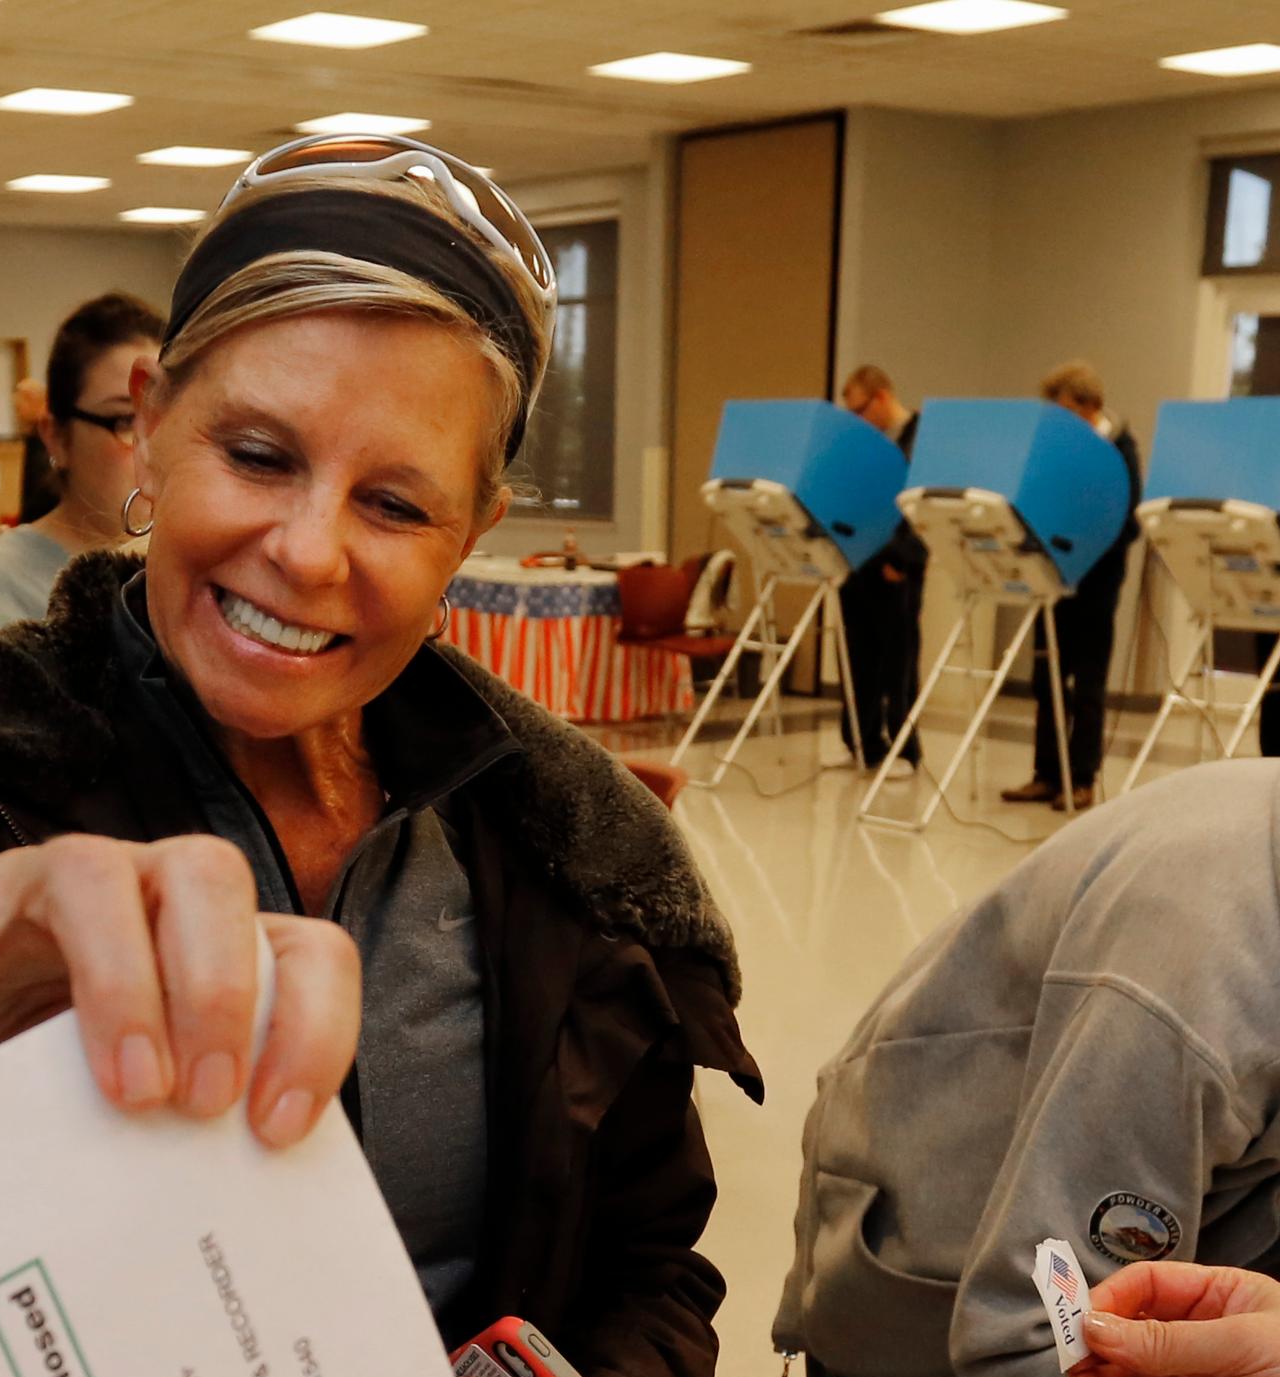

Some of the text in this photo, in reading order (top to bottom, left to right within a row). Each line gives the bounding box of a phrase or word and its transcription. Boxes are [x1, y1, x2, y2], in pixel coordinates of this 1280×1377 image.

[1109, 1194, 1162, 1216] POWDER
[199, 1233, 259, 1362] RECORDER
[1071, 1308, 1083, 1317] I
[1054, 1294, 1076, 1346] Voted
